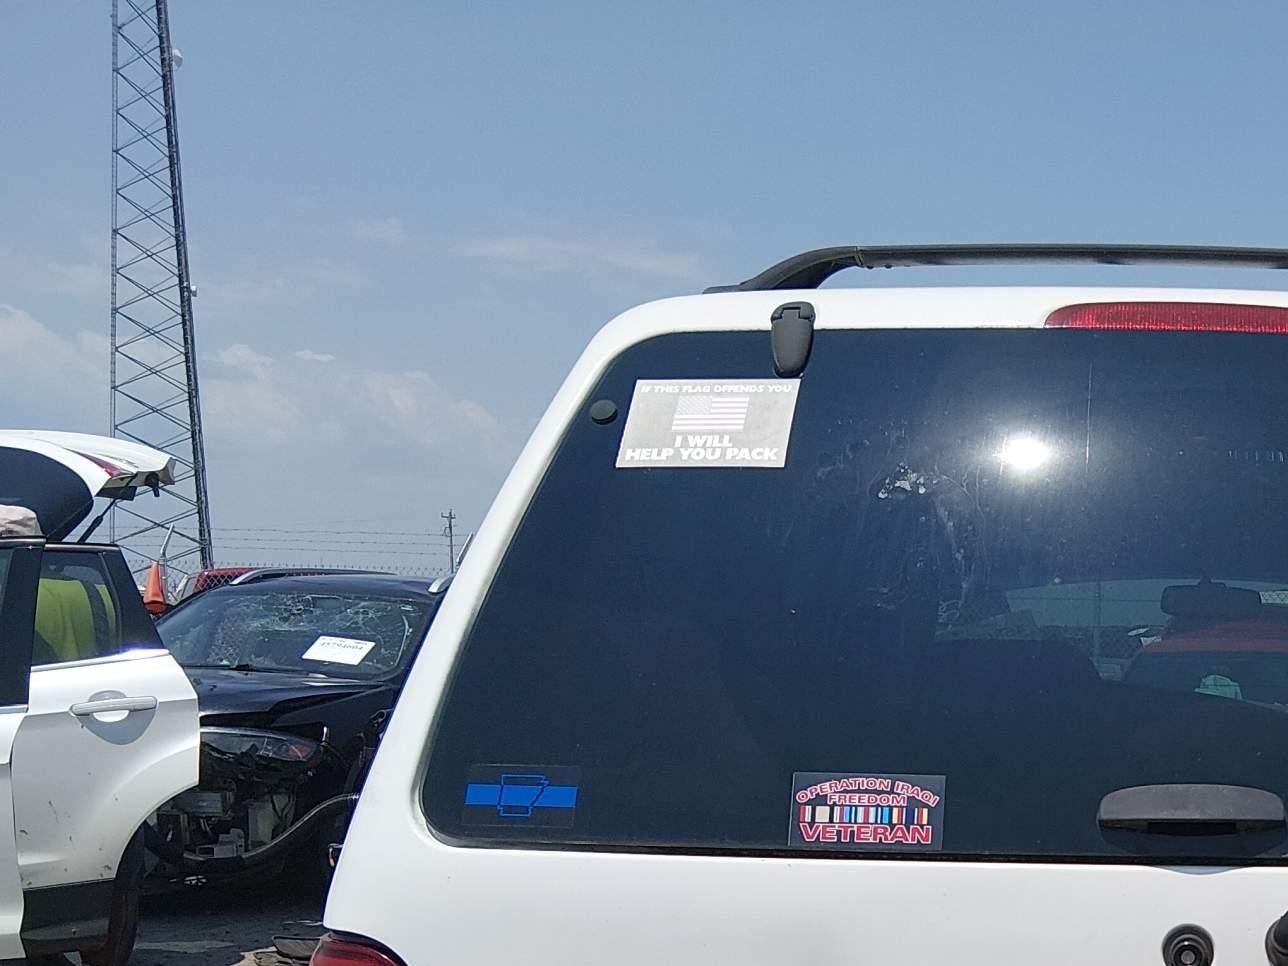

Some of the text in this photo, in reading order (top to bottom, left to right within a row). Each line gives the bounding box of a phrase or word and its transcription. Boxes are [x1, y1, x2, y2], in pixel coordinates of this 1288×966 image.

[641, 385, 792, 393] IF THIS FLAG OFFENDS YOU
[674, 435, 733, 448] I WILL
[624, 448, 779, 461] HELP YOU PACK
[796, 777, 940, 807] OPERATION IRAQI
[827, 793, 908, 806] FREEDOM
[800, 822, 932, 844] VETERAN
